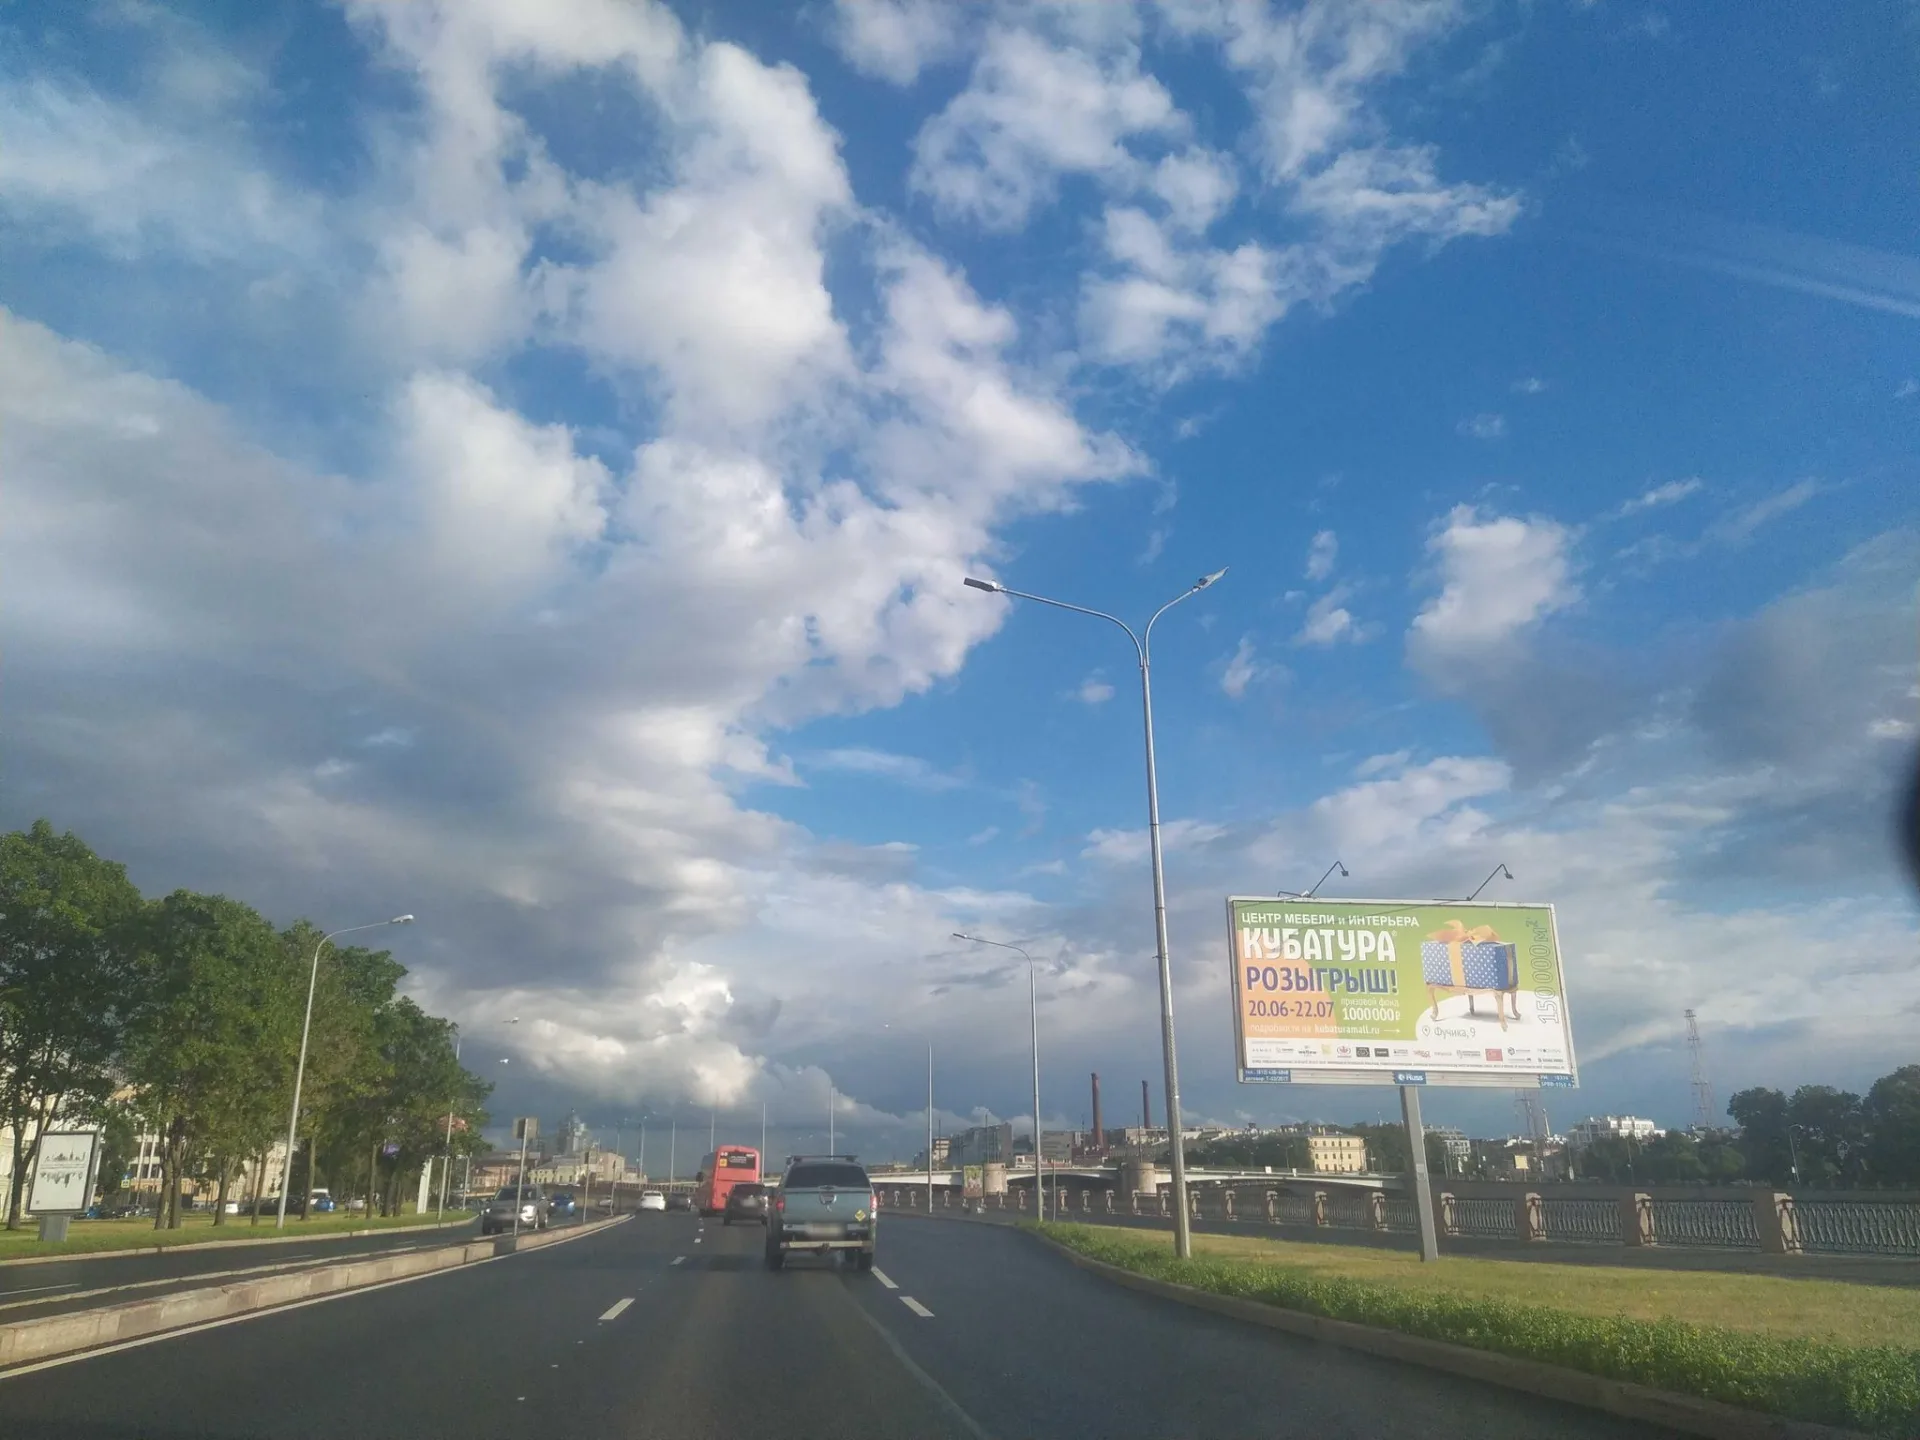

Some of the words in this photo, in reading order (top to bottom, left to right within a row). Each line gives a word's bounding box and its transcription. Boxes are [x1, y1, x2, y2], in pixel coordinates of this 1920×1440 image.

[1241, 912, 1281, 925] ЦЕНТР
[1284, 914, 1335, 925] МЕБЕЛИ
[1348, 915, 1420, 927] ИНТЕРЬЕРА
[1242, 927, 1396, 962] КУБАТУРА
[1246, 966, 1399, 995] РОЗЫГРЫШ!
[1248, 1000, 1335, 1018] 20.06-22.07
[1314, 1024, 1380, 1036] kubaturamall.ru
